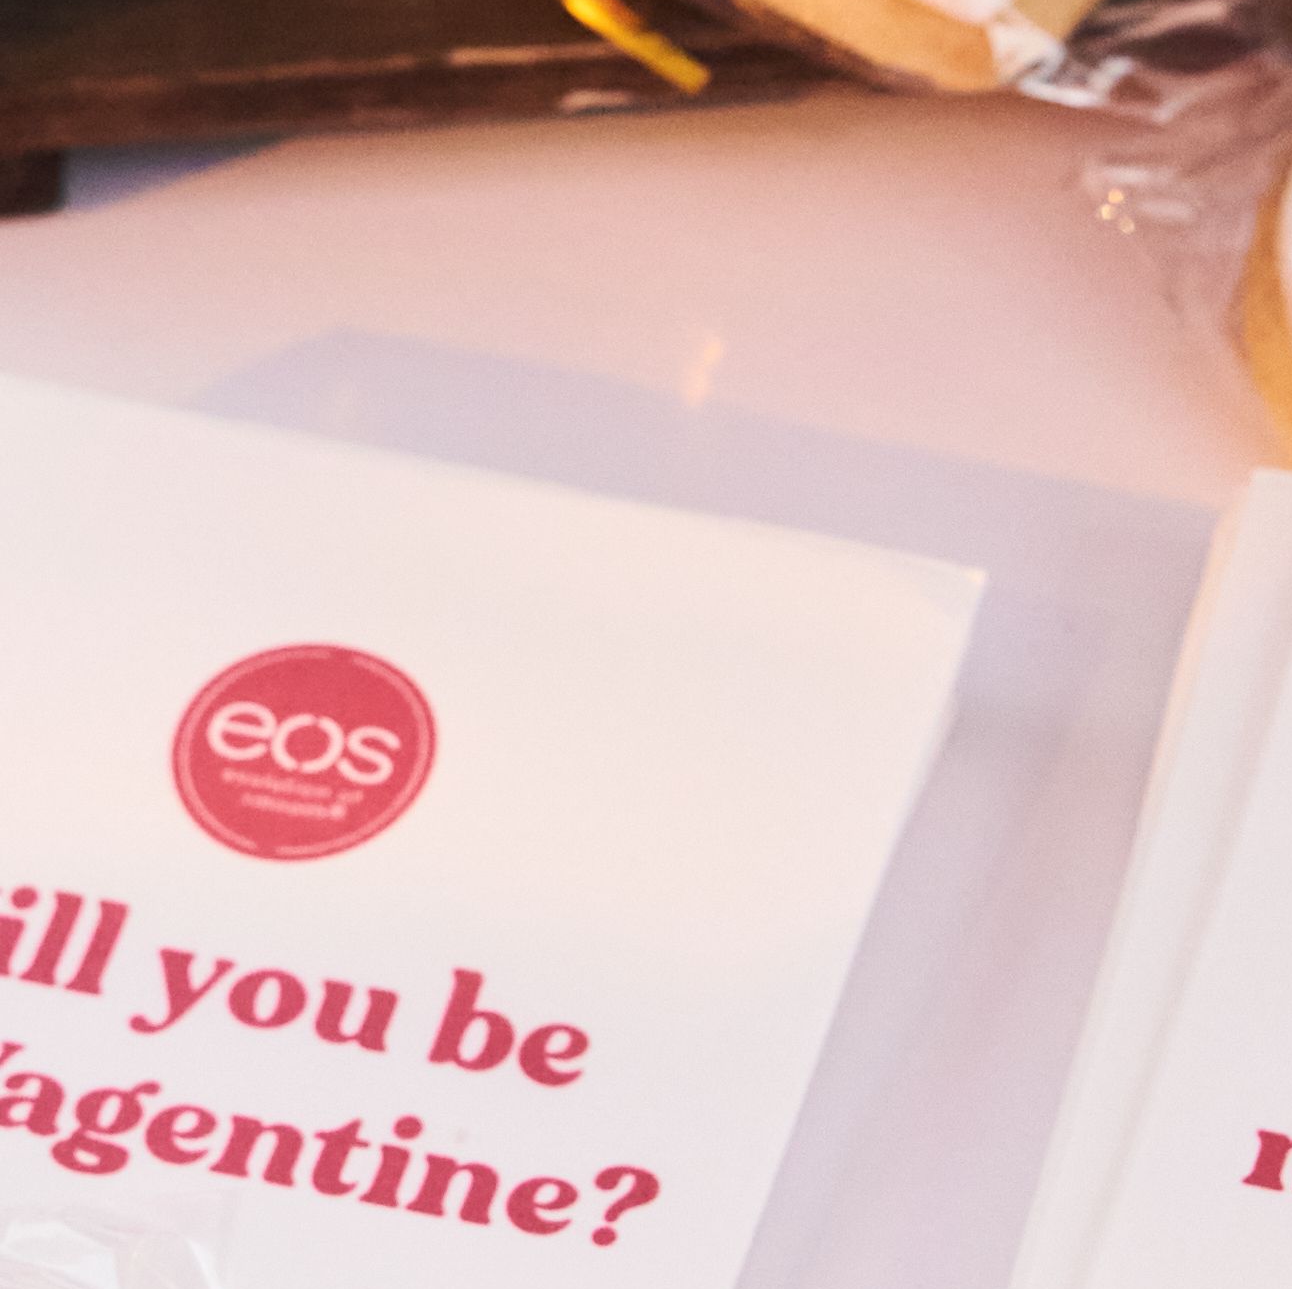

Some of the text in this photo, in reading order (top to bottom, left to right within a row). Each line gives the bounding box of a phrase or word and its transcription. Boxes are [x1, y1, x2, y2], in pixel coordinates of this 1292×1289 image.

[206, 701, 401, 786] eos
[0, 884, 591, 1088] ill you be
[0, 1040, 662, 1249] agentine?
